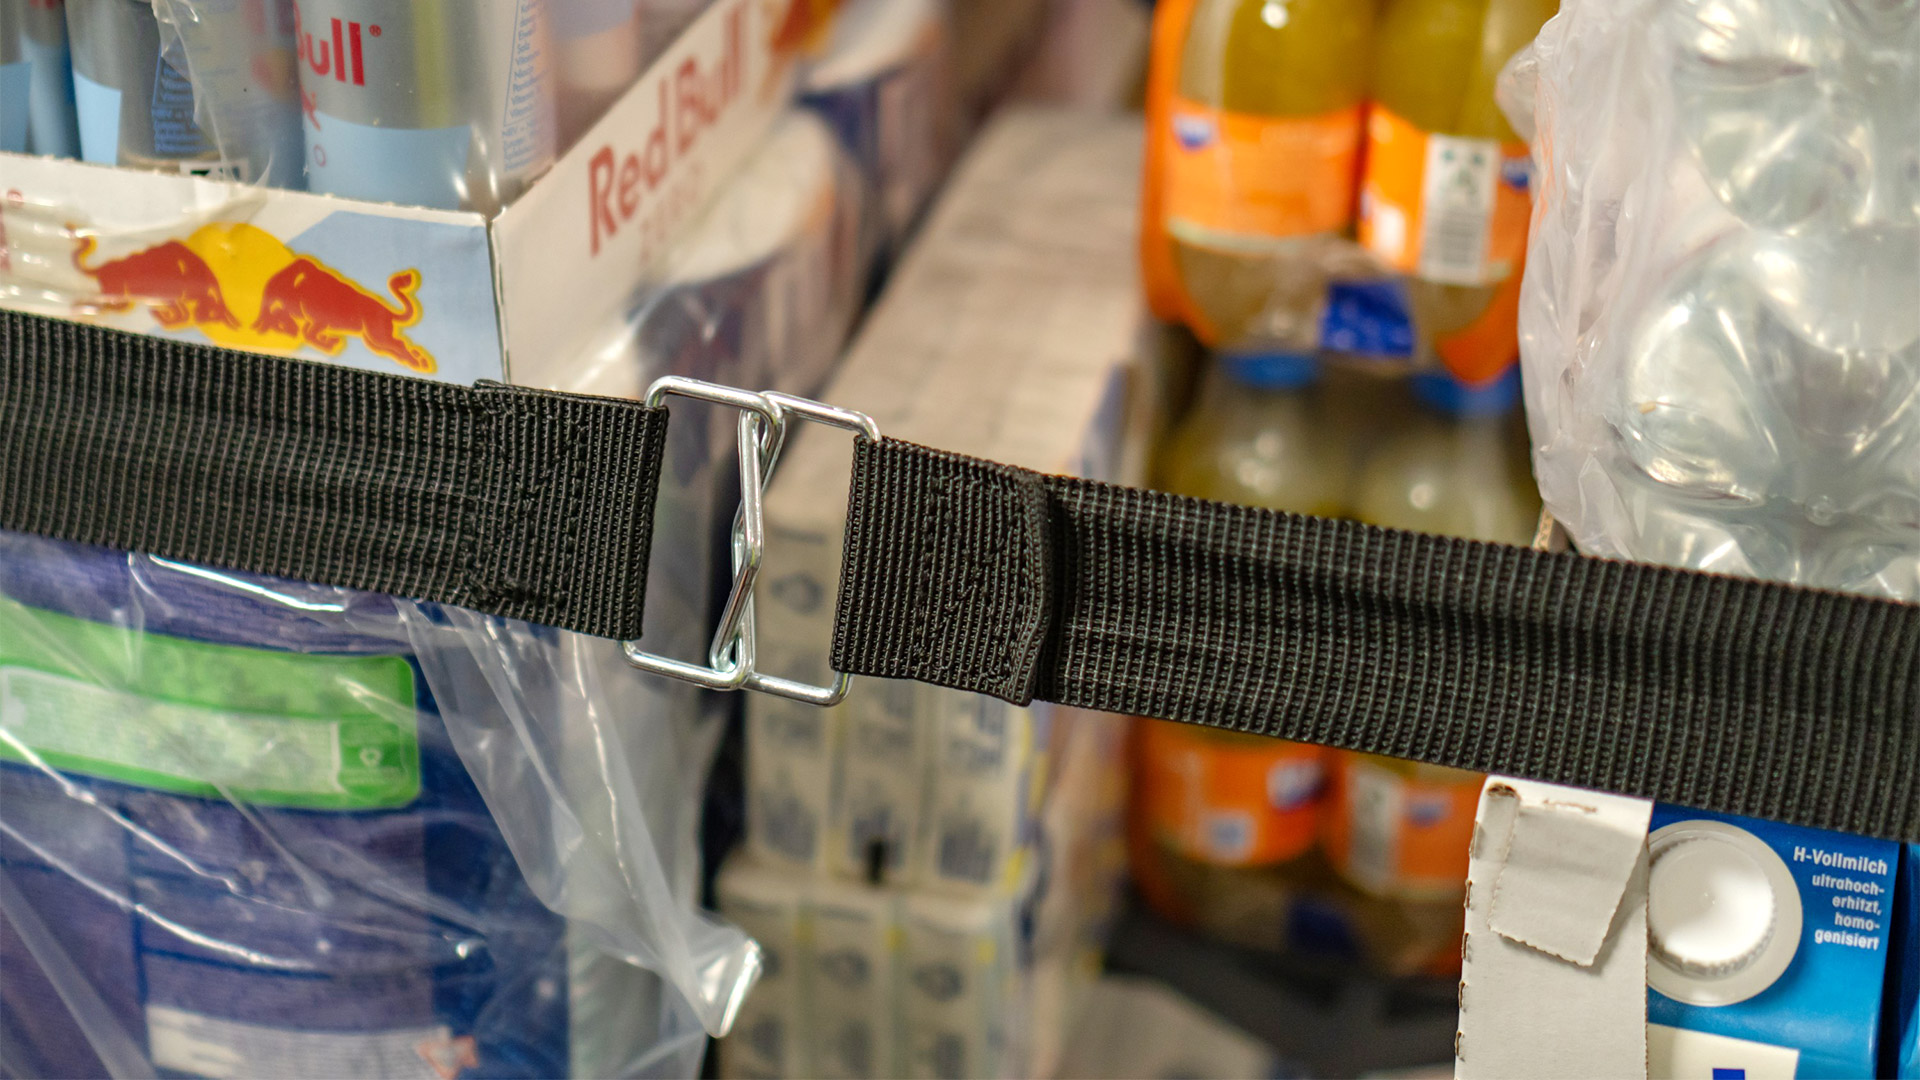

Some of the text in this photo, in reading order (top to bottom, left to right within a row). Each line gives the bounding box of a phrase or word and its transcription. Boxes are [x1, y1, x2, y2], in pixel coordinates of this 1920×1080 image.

[587, 78, 668, 259] Red
[1793, 845, 1888, 876] H-Vollmilch
[1811, 873, 1885, 896] ultrahoch-
[1831, 895, 1882, 916] erhitzt,
[1834, 911, 1881, 932] homo-
[1814, 928, 1880, 951] genisiert
